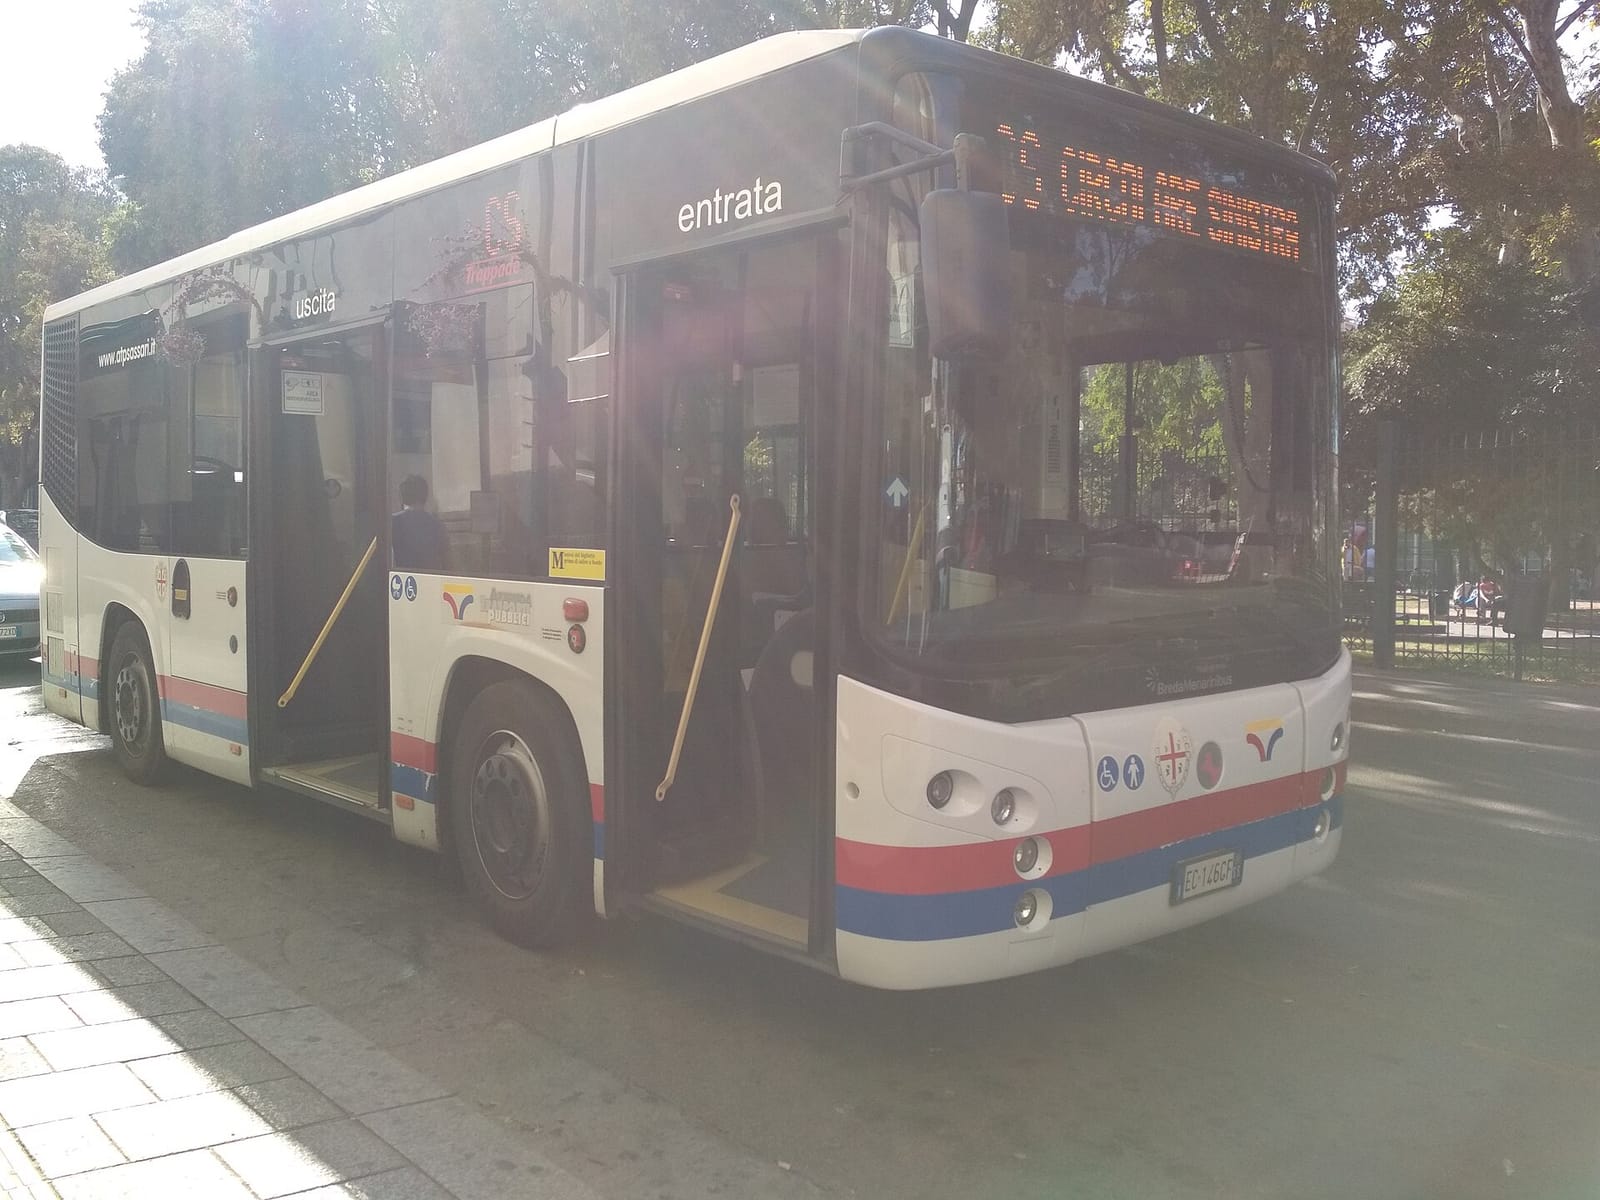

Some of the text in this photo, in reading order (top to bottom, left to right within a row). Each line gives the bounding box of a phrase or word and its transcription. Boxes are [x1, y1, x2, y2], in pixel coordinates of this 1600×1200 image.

[484, 190, 522, 255] CS
[678, 177, 782, 232] entrata
[296, 288, 336, 319] uscita
[98, 337, 156, 368] www.atpsassari.it
